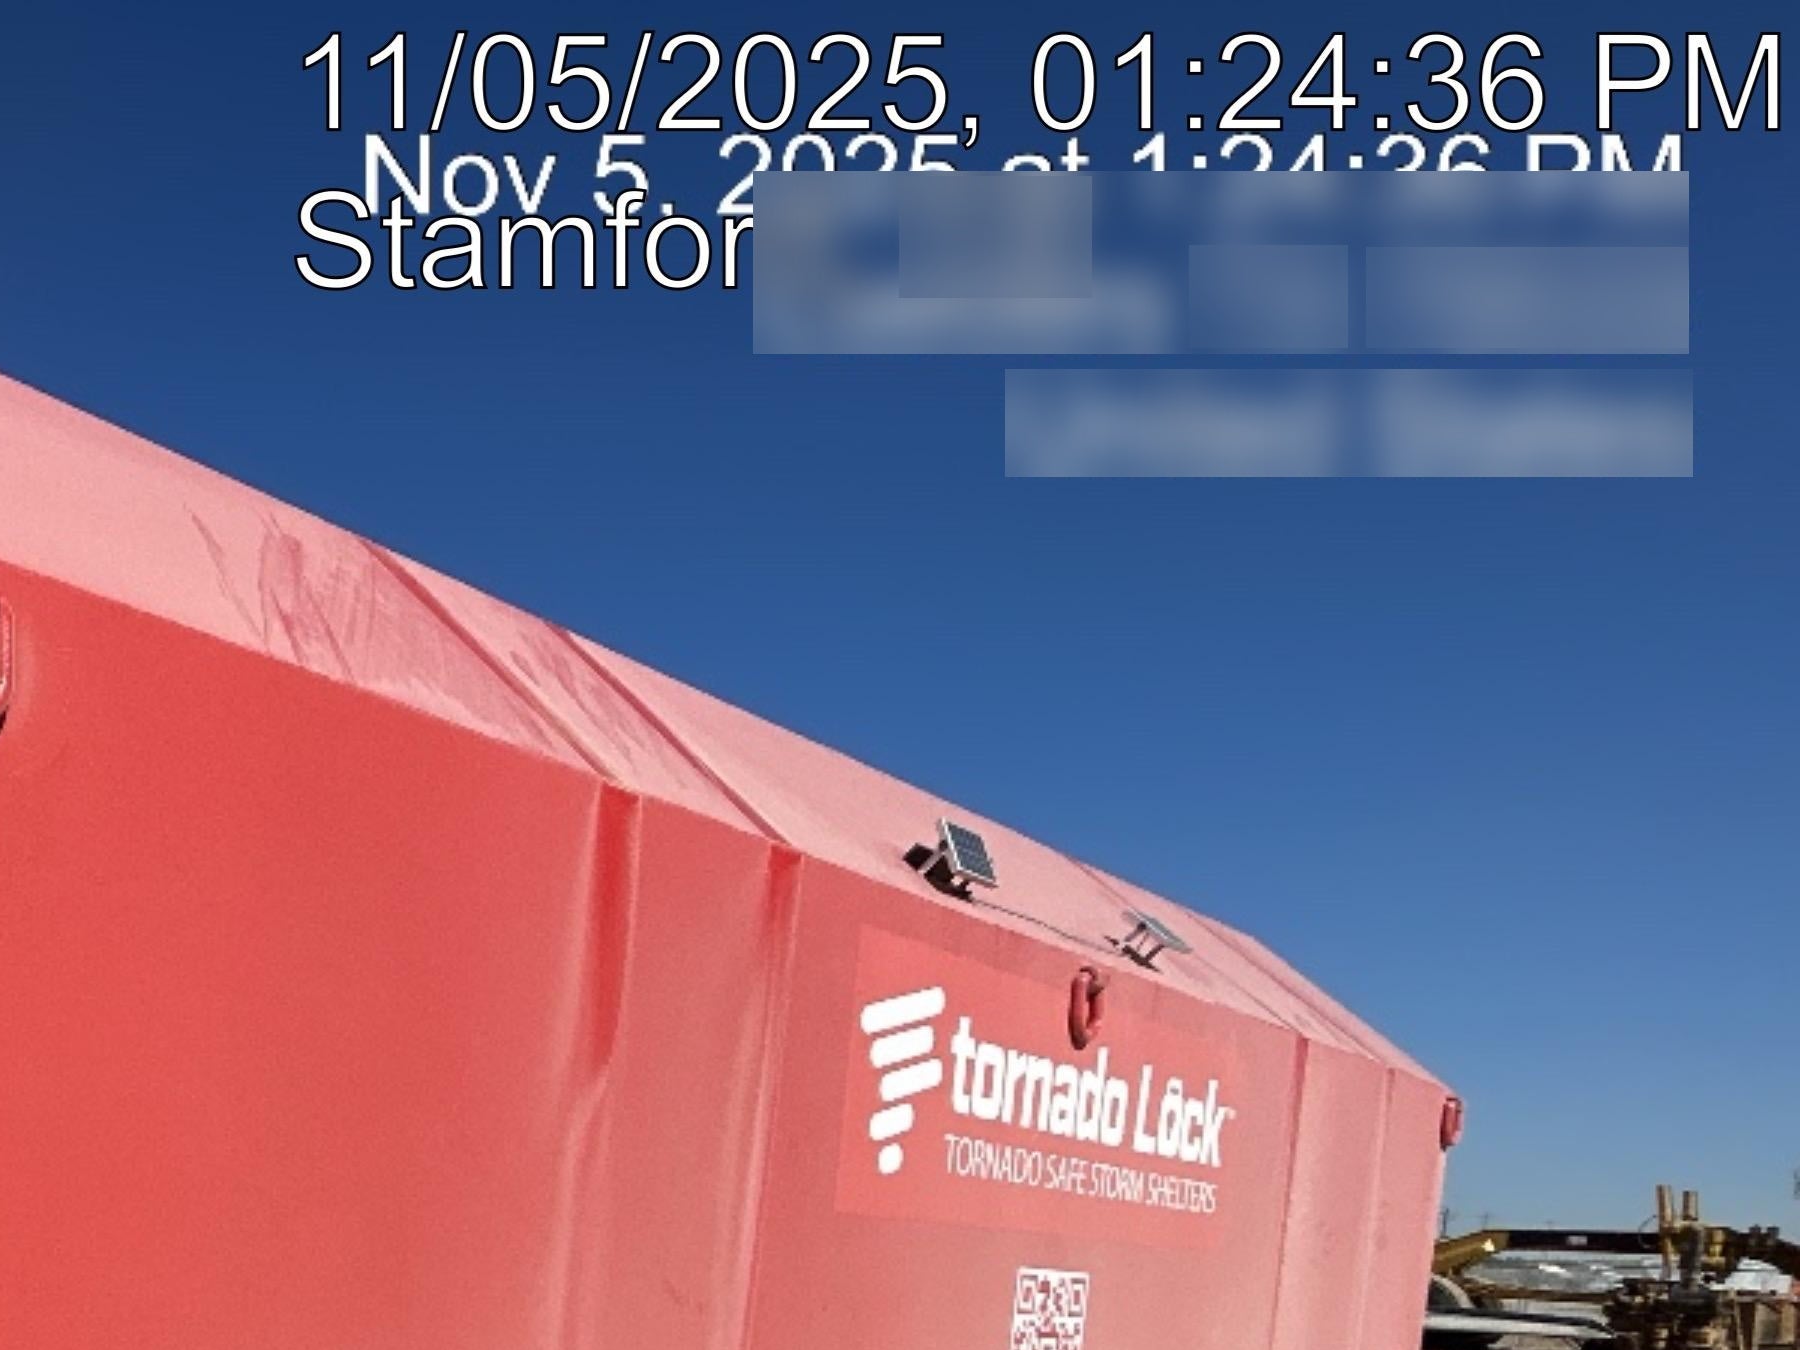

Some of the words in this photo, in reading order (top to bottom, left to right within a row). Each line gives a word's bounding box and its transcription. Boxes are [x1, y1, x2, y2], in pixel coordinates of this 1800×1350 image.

[950, 1015, 1129, 1147] tornado
[944, 1133, 1042, 1188] TORNADO
[1043, 1153, 1089, 1196] SAFE
[1088, 1161, 1144, 1203] STORM
[1145, 1172, 1219, 1214] SHELTERS
